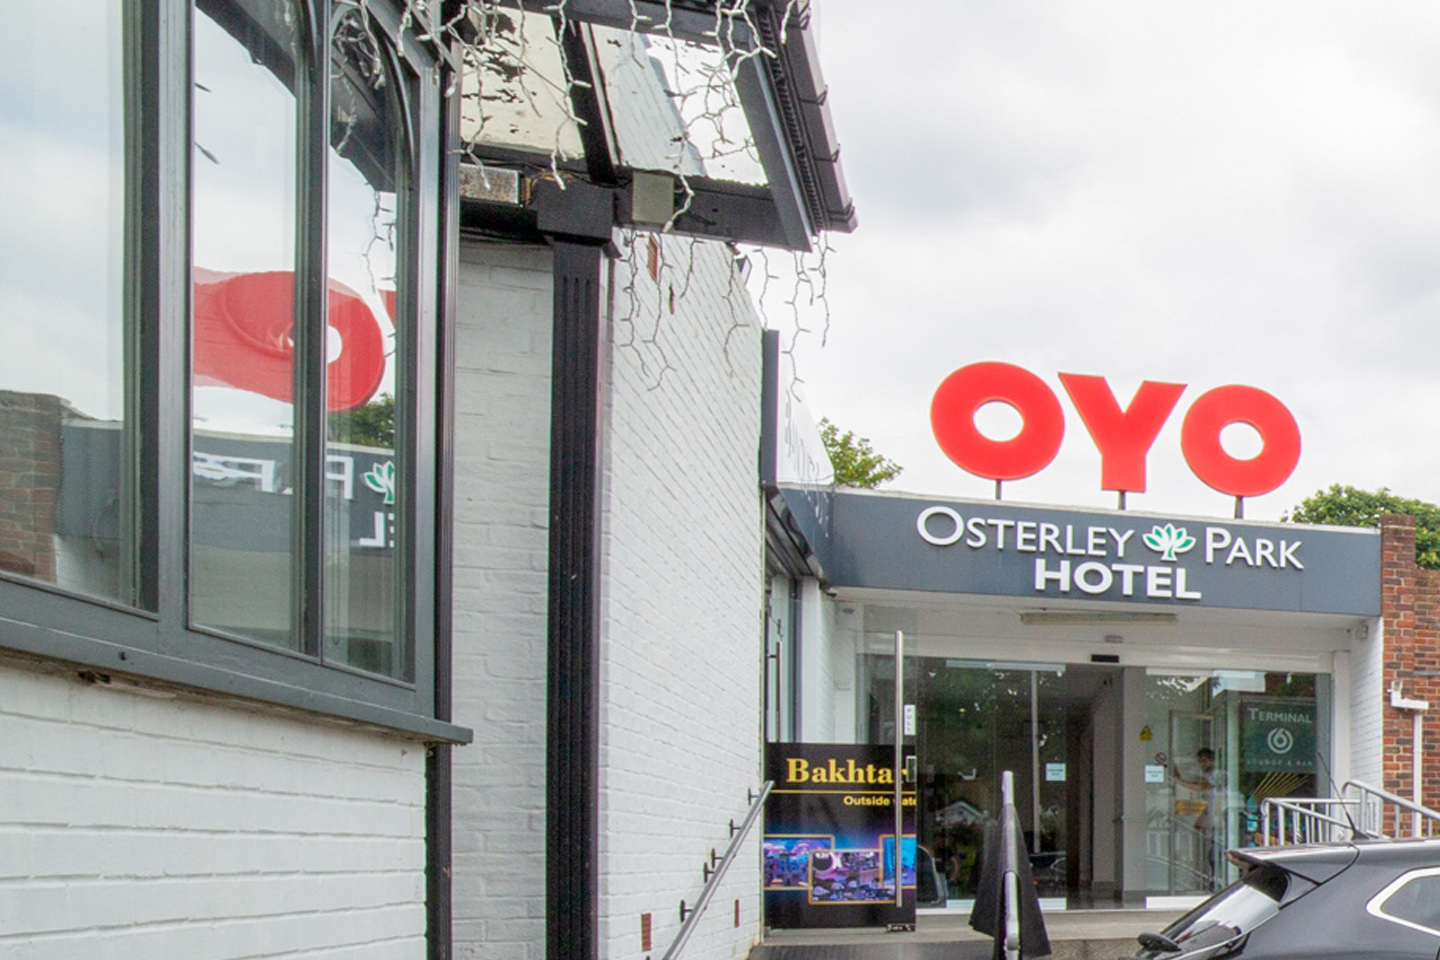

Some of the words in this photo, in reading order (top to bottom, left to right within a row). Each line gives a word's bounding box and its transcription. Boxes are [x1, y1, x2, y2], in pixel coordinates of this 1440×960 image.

[930, 361, 1302, 498] OYO
[916, 506, 1135, 558] OSTERLEY
[1205, 526, 1305, 570] PARK
[1034, 558, 1202, 600] HOTEL
[1247, 708, 1313, 724] TERMINAL
[843, 795, 891, 806] Outside
